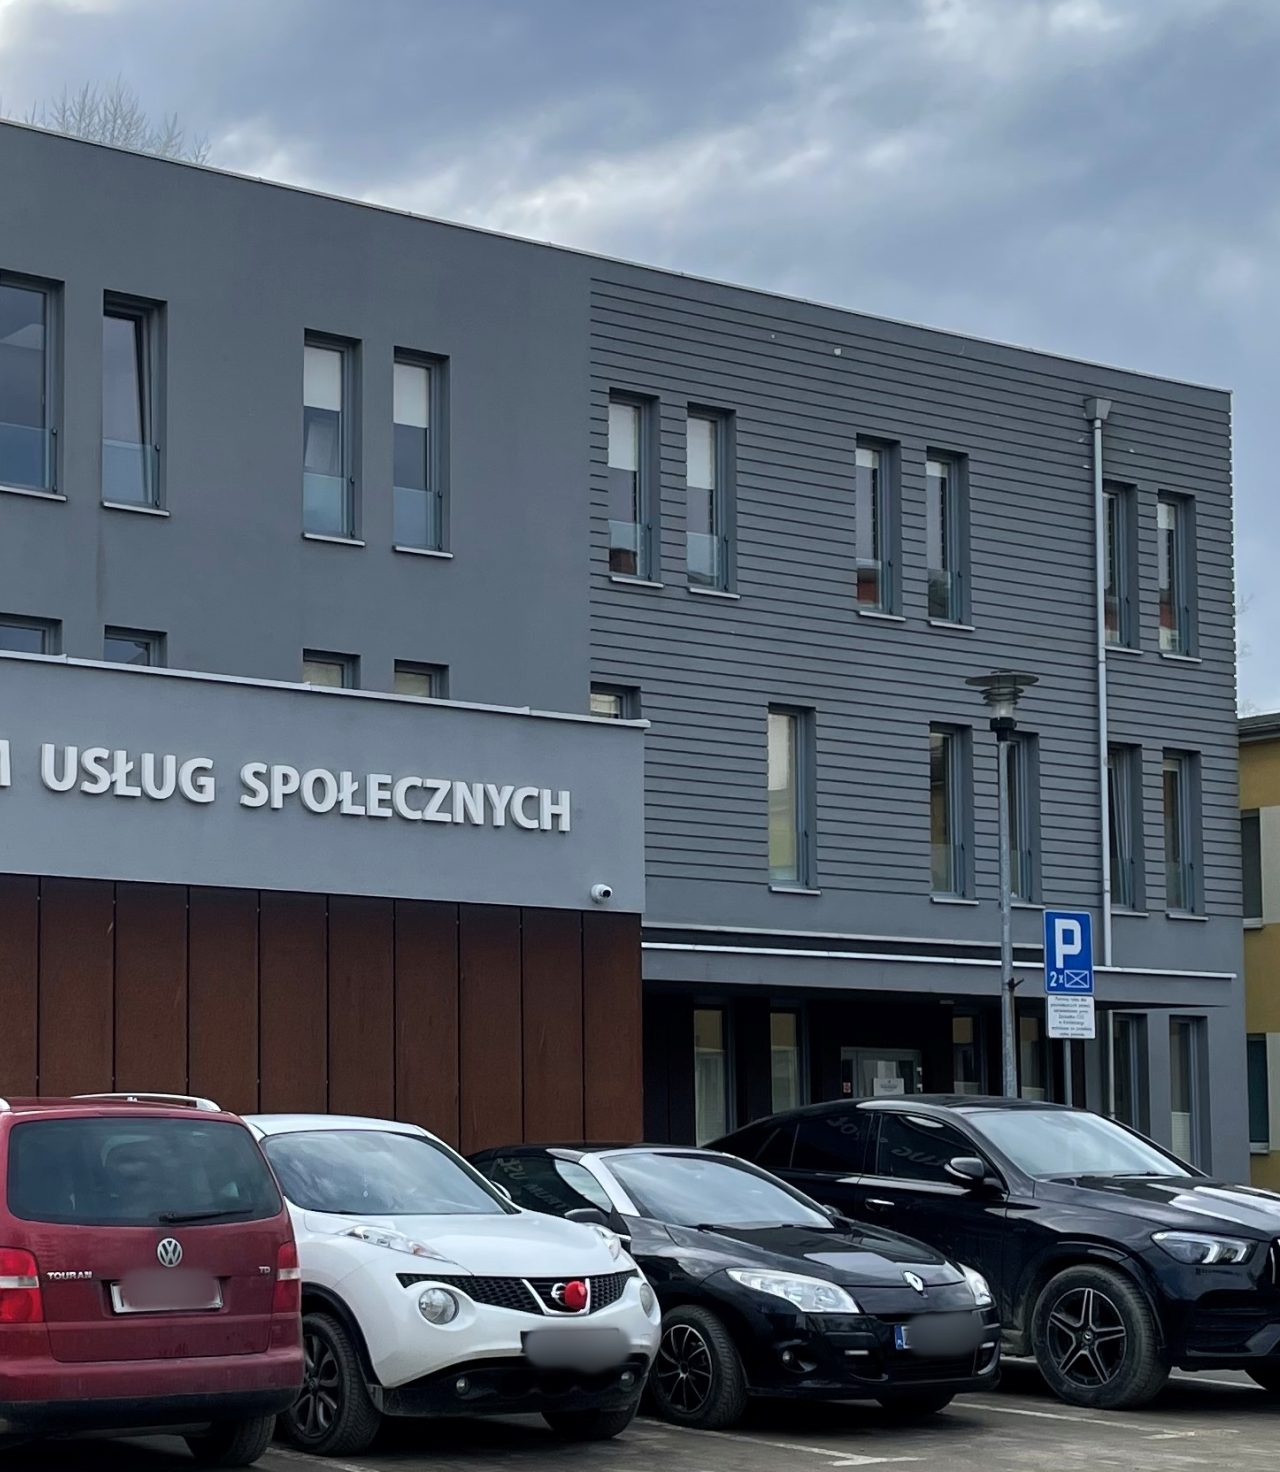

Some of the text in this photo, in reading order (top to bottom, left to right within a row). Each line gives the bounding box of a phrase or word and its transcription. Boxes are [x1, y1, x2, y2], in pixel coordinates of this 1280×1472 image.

[41, 743, 216, 803] USŁUG
[240, 762, 571, 832] SPOŁECZNYCH
[1054, 918, 1082, 969] P
[47, 1270, 93, 1280] TOURAN
